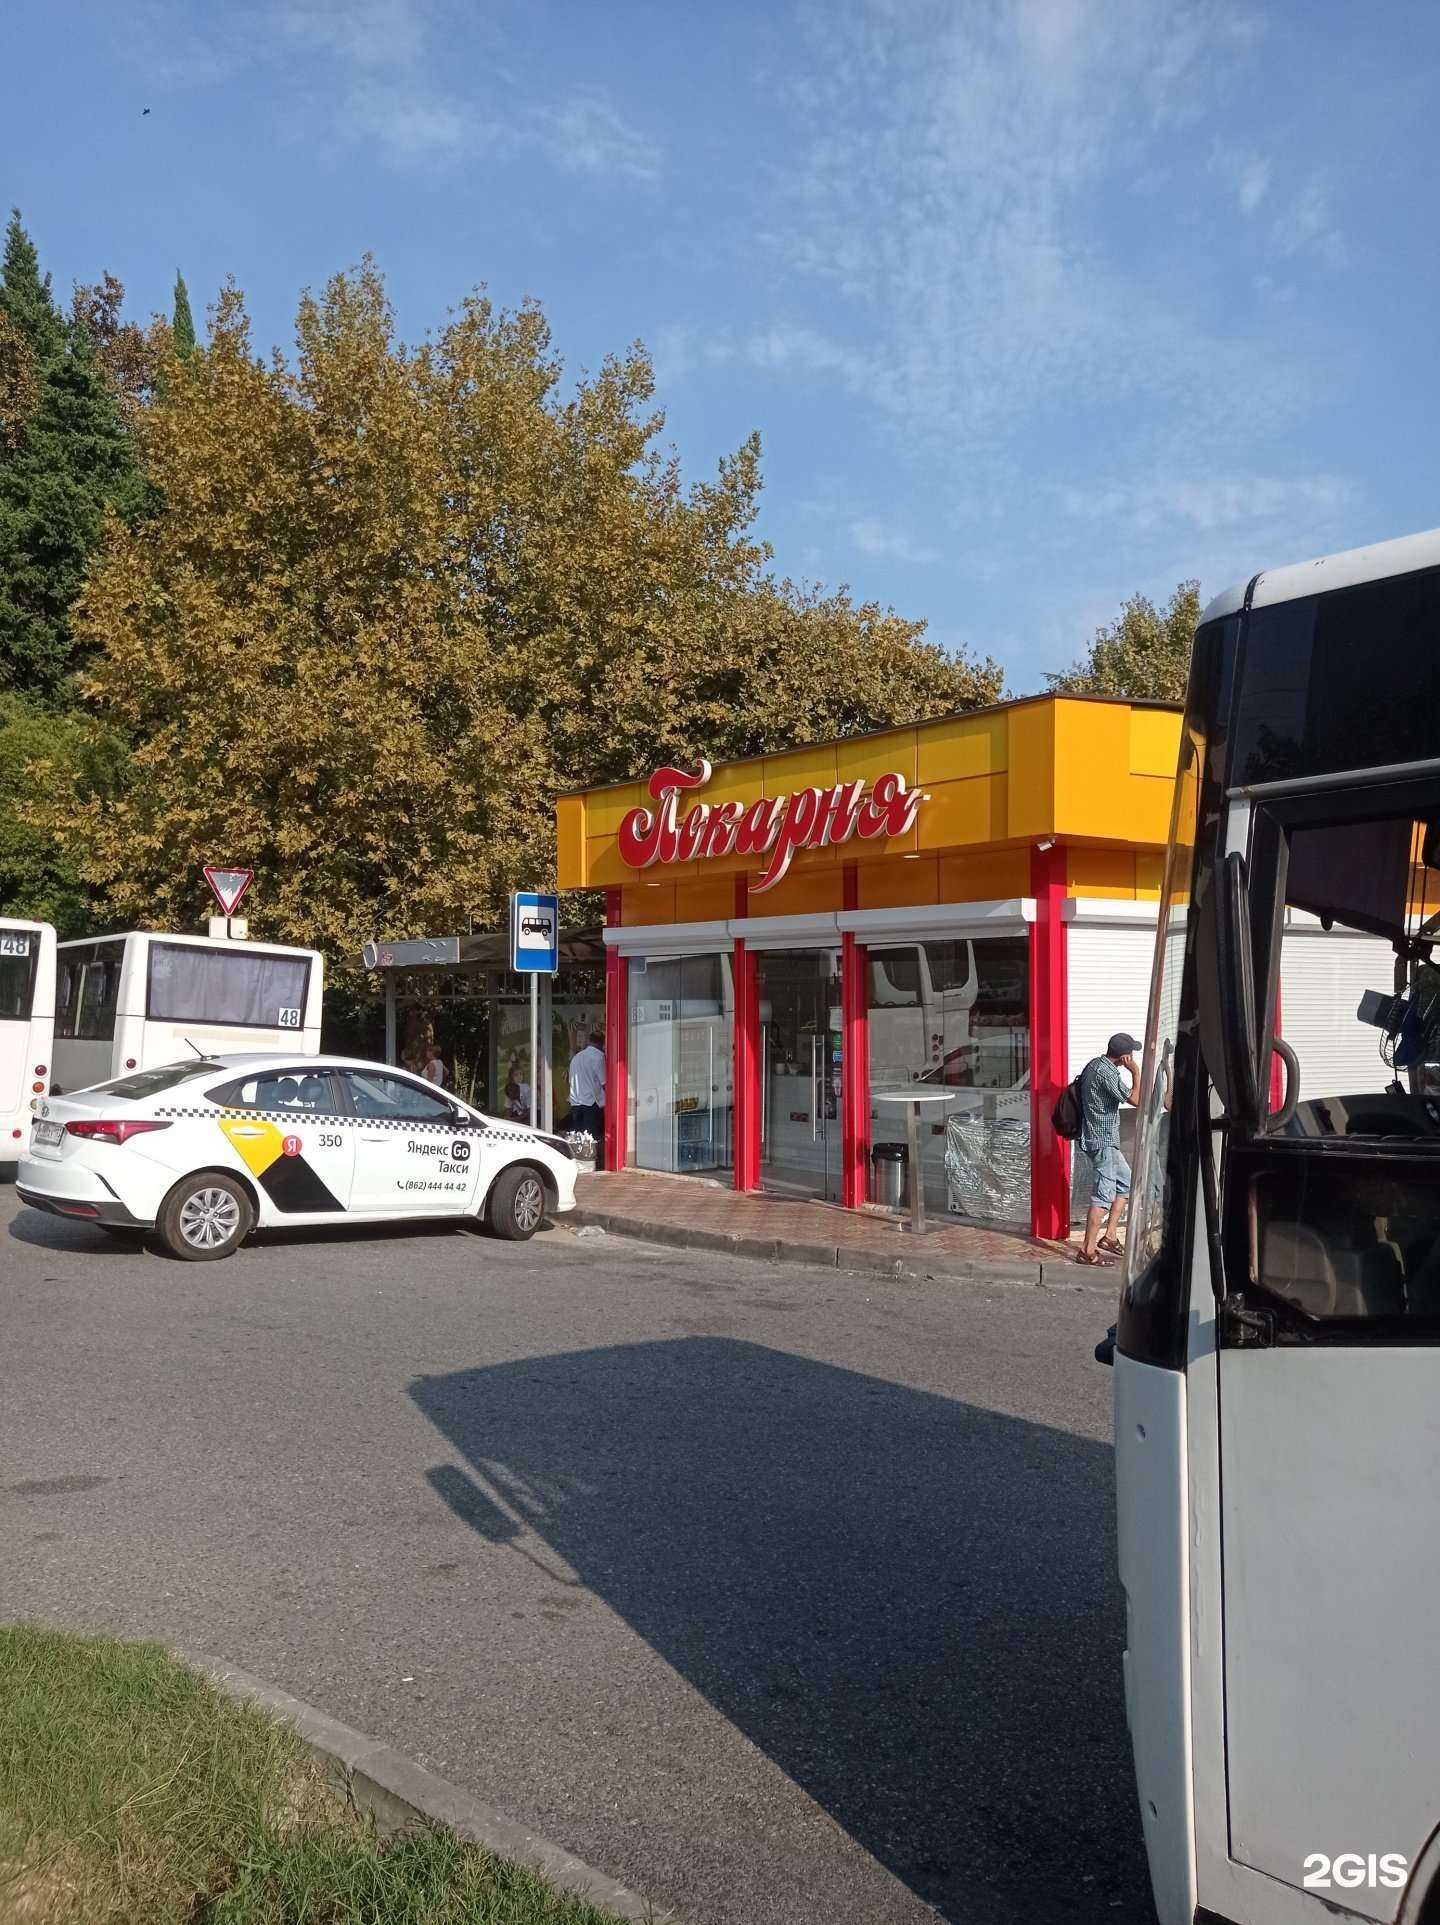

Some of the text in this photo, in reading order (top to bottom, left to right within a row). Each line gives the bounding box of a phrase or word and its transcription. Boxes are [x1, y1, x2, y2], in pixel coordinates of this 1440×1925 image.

[618, 758, 931, 893] Пекарня
[281, 1010, 298, 1025] 48
[319, 1135, 342, 1147] 350
[407, 1140, 469, 1158] Яндекс Go
[438, 1160, 469, 1174] Такси
[405, 1180, 427, 1191] (862)
[428, 1182, 442, 1190] 444
[456, 1183, 467, 1191] 42
